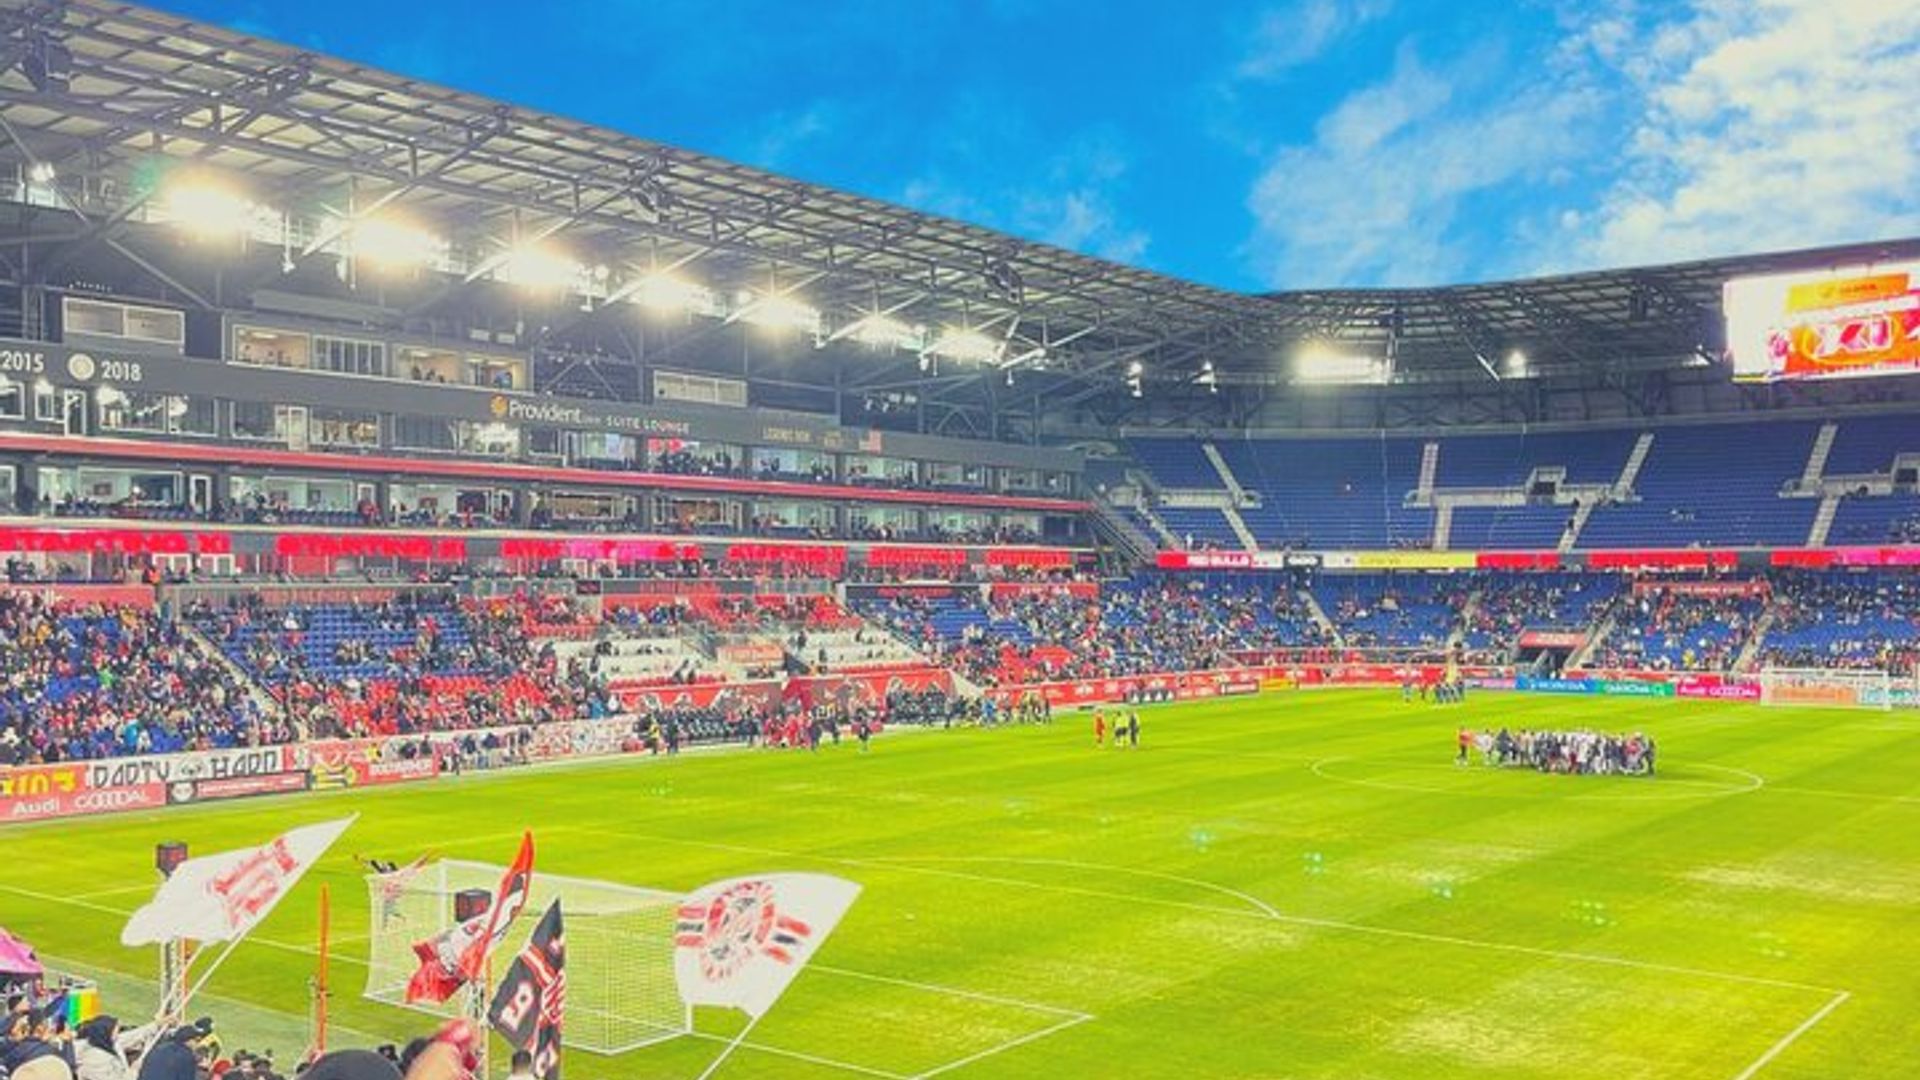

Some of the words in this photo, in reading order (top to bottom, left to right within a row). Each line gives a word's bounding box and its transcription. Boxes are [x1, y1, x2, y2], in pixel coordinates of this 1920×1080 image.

[0, 350, 44, 373] 2015
[100, 360, 142, 381] 2018
[508, 399, 581, 424] Provident
[606, 416, 639, 429] SUITE
[12, 796, 60, 815] Audi
